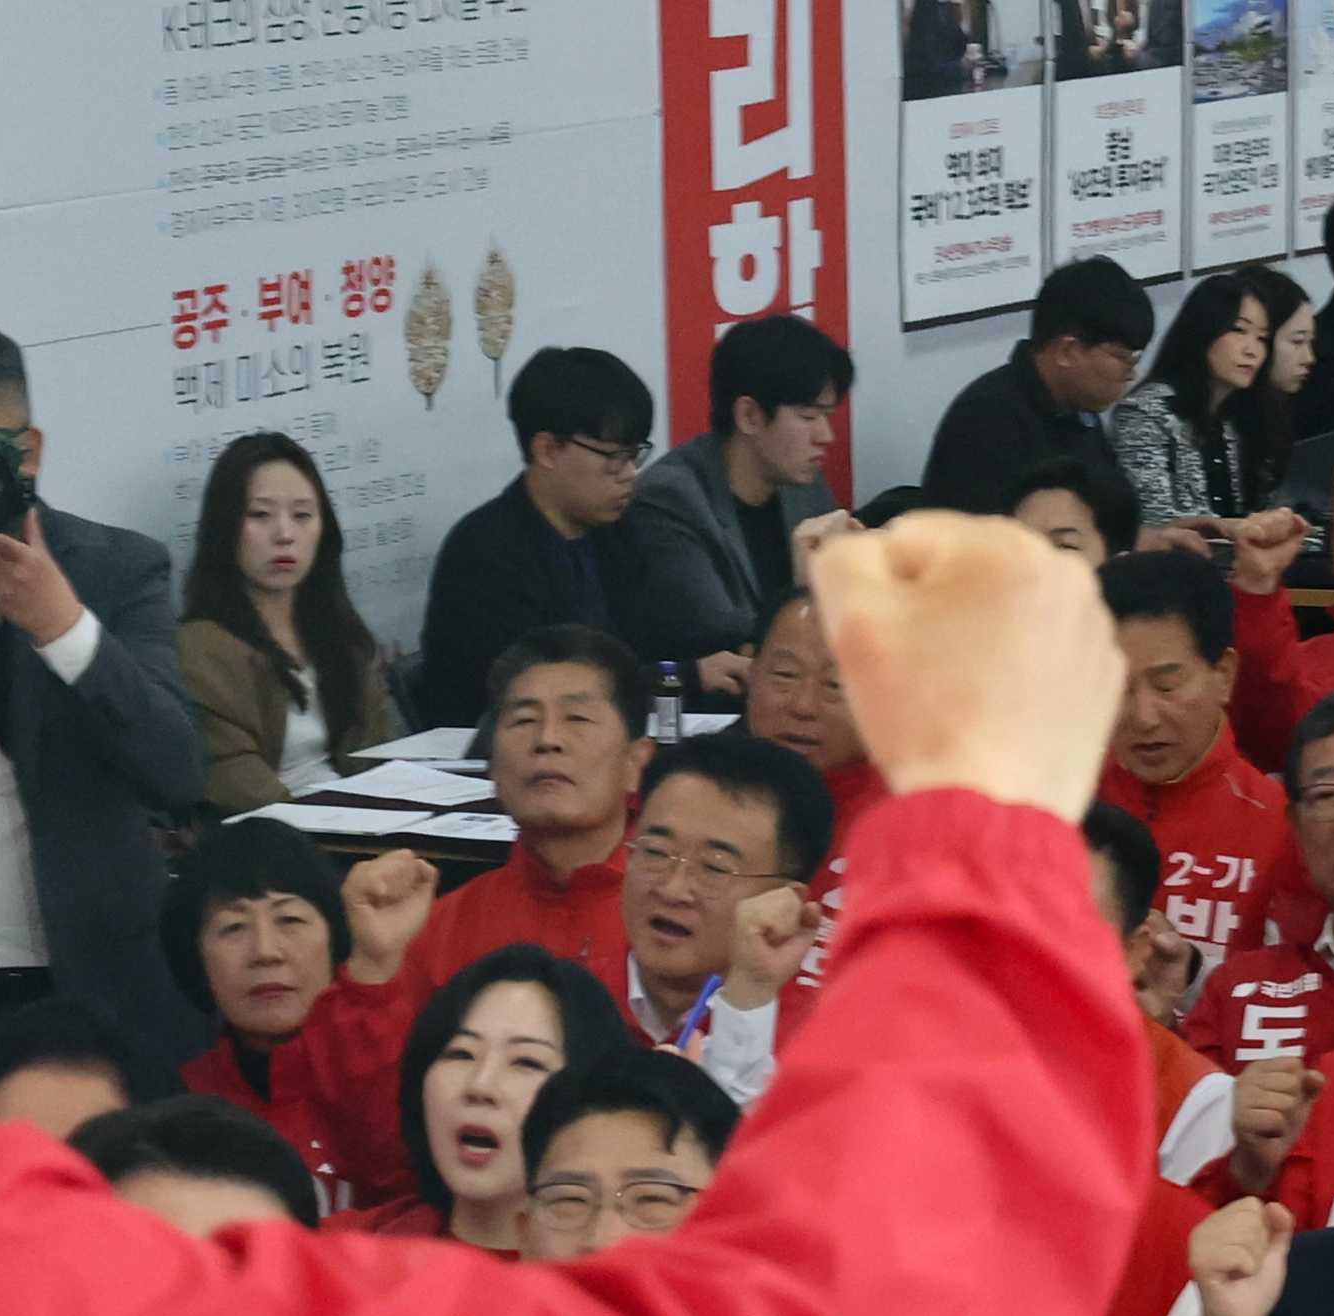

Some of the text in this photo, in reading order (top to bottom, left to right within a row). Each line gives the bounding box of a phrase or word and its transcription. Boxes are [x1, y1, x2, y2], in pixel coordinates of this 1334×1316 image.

[171, 254, 398, 350] 공주 부여 청양
[1234, 1003, 1309, 1062] 도
